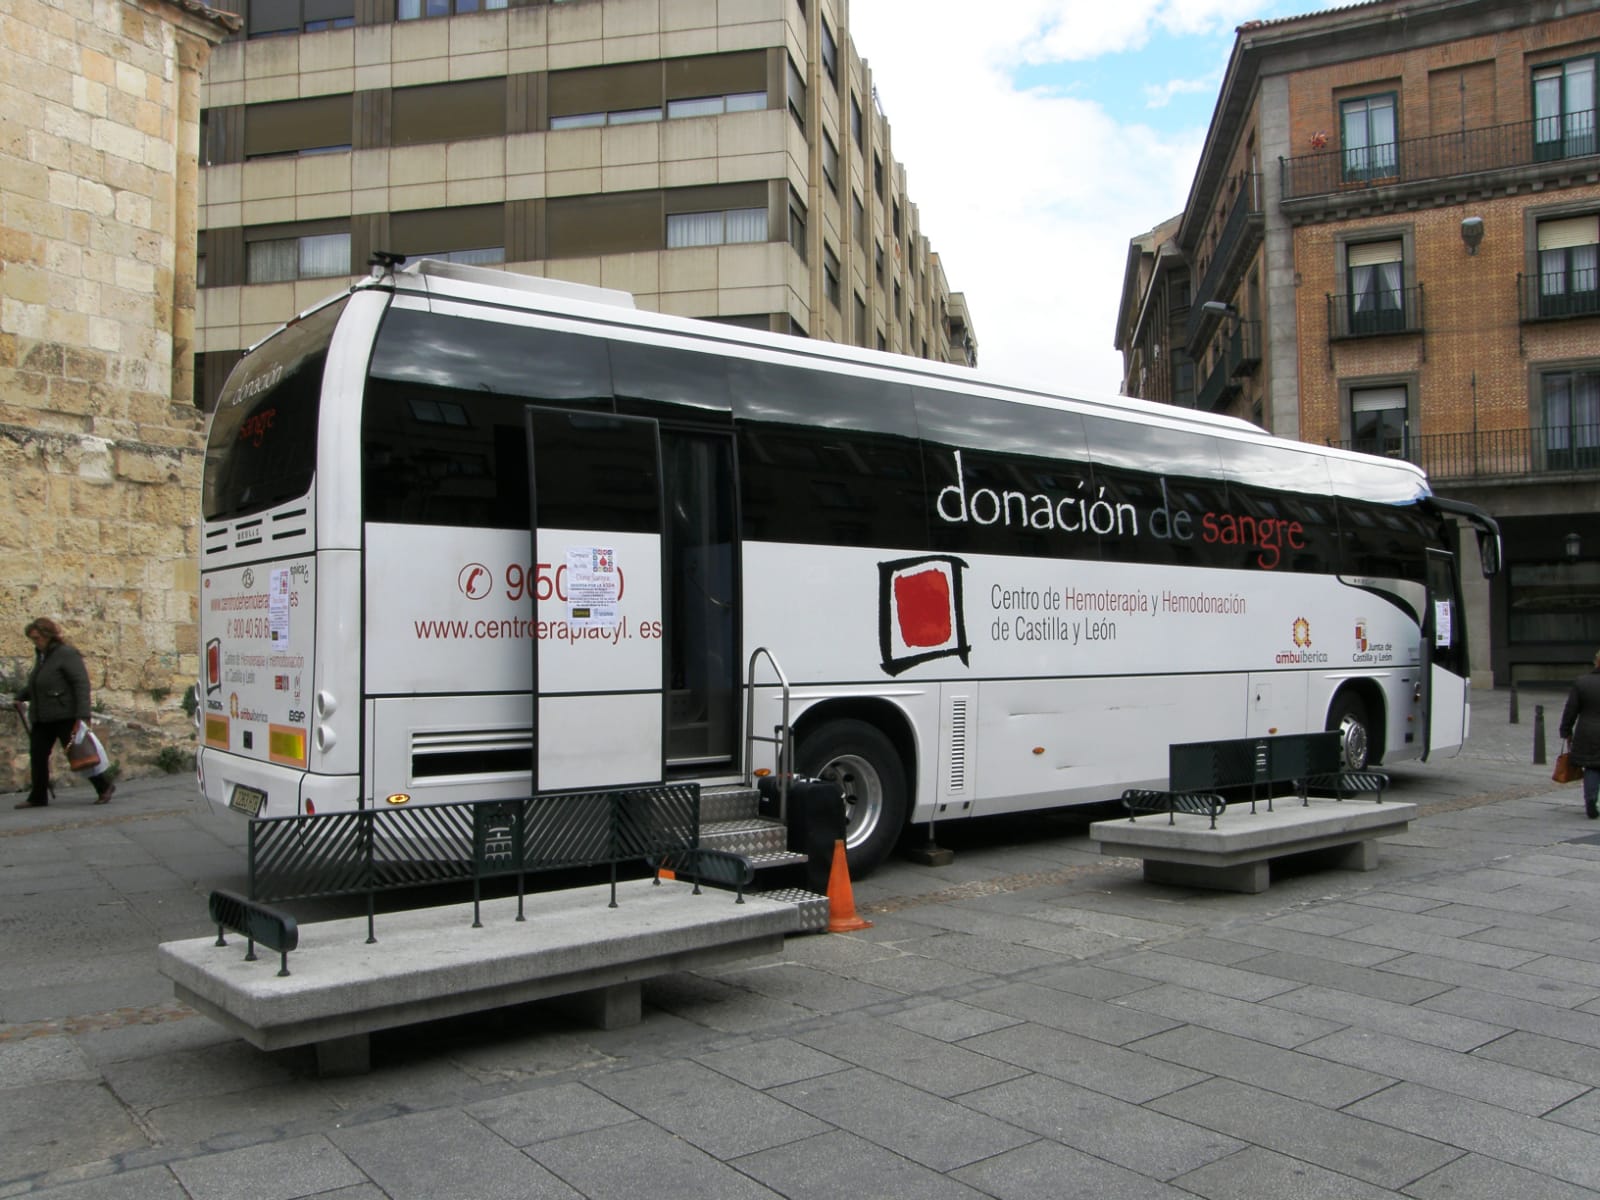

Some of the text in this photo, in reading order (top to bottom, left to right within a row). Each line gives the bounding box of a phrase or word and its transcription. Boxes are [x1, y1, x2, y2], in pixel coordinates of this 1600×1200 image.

[936, 450, 1305, 569] donación de sangre
[991, 583, 1247, 617] Centro de Hemoterapia y Hemodonación
[991, 615, 1116, 646] de Castilla y León
[1275, 650, 1328, 664] ambuiberica
[1352, 652, 1373, 662] Castilla
[1379, 652, 1393, 662] León
[1368, 642, 1392, 652] Junta de
